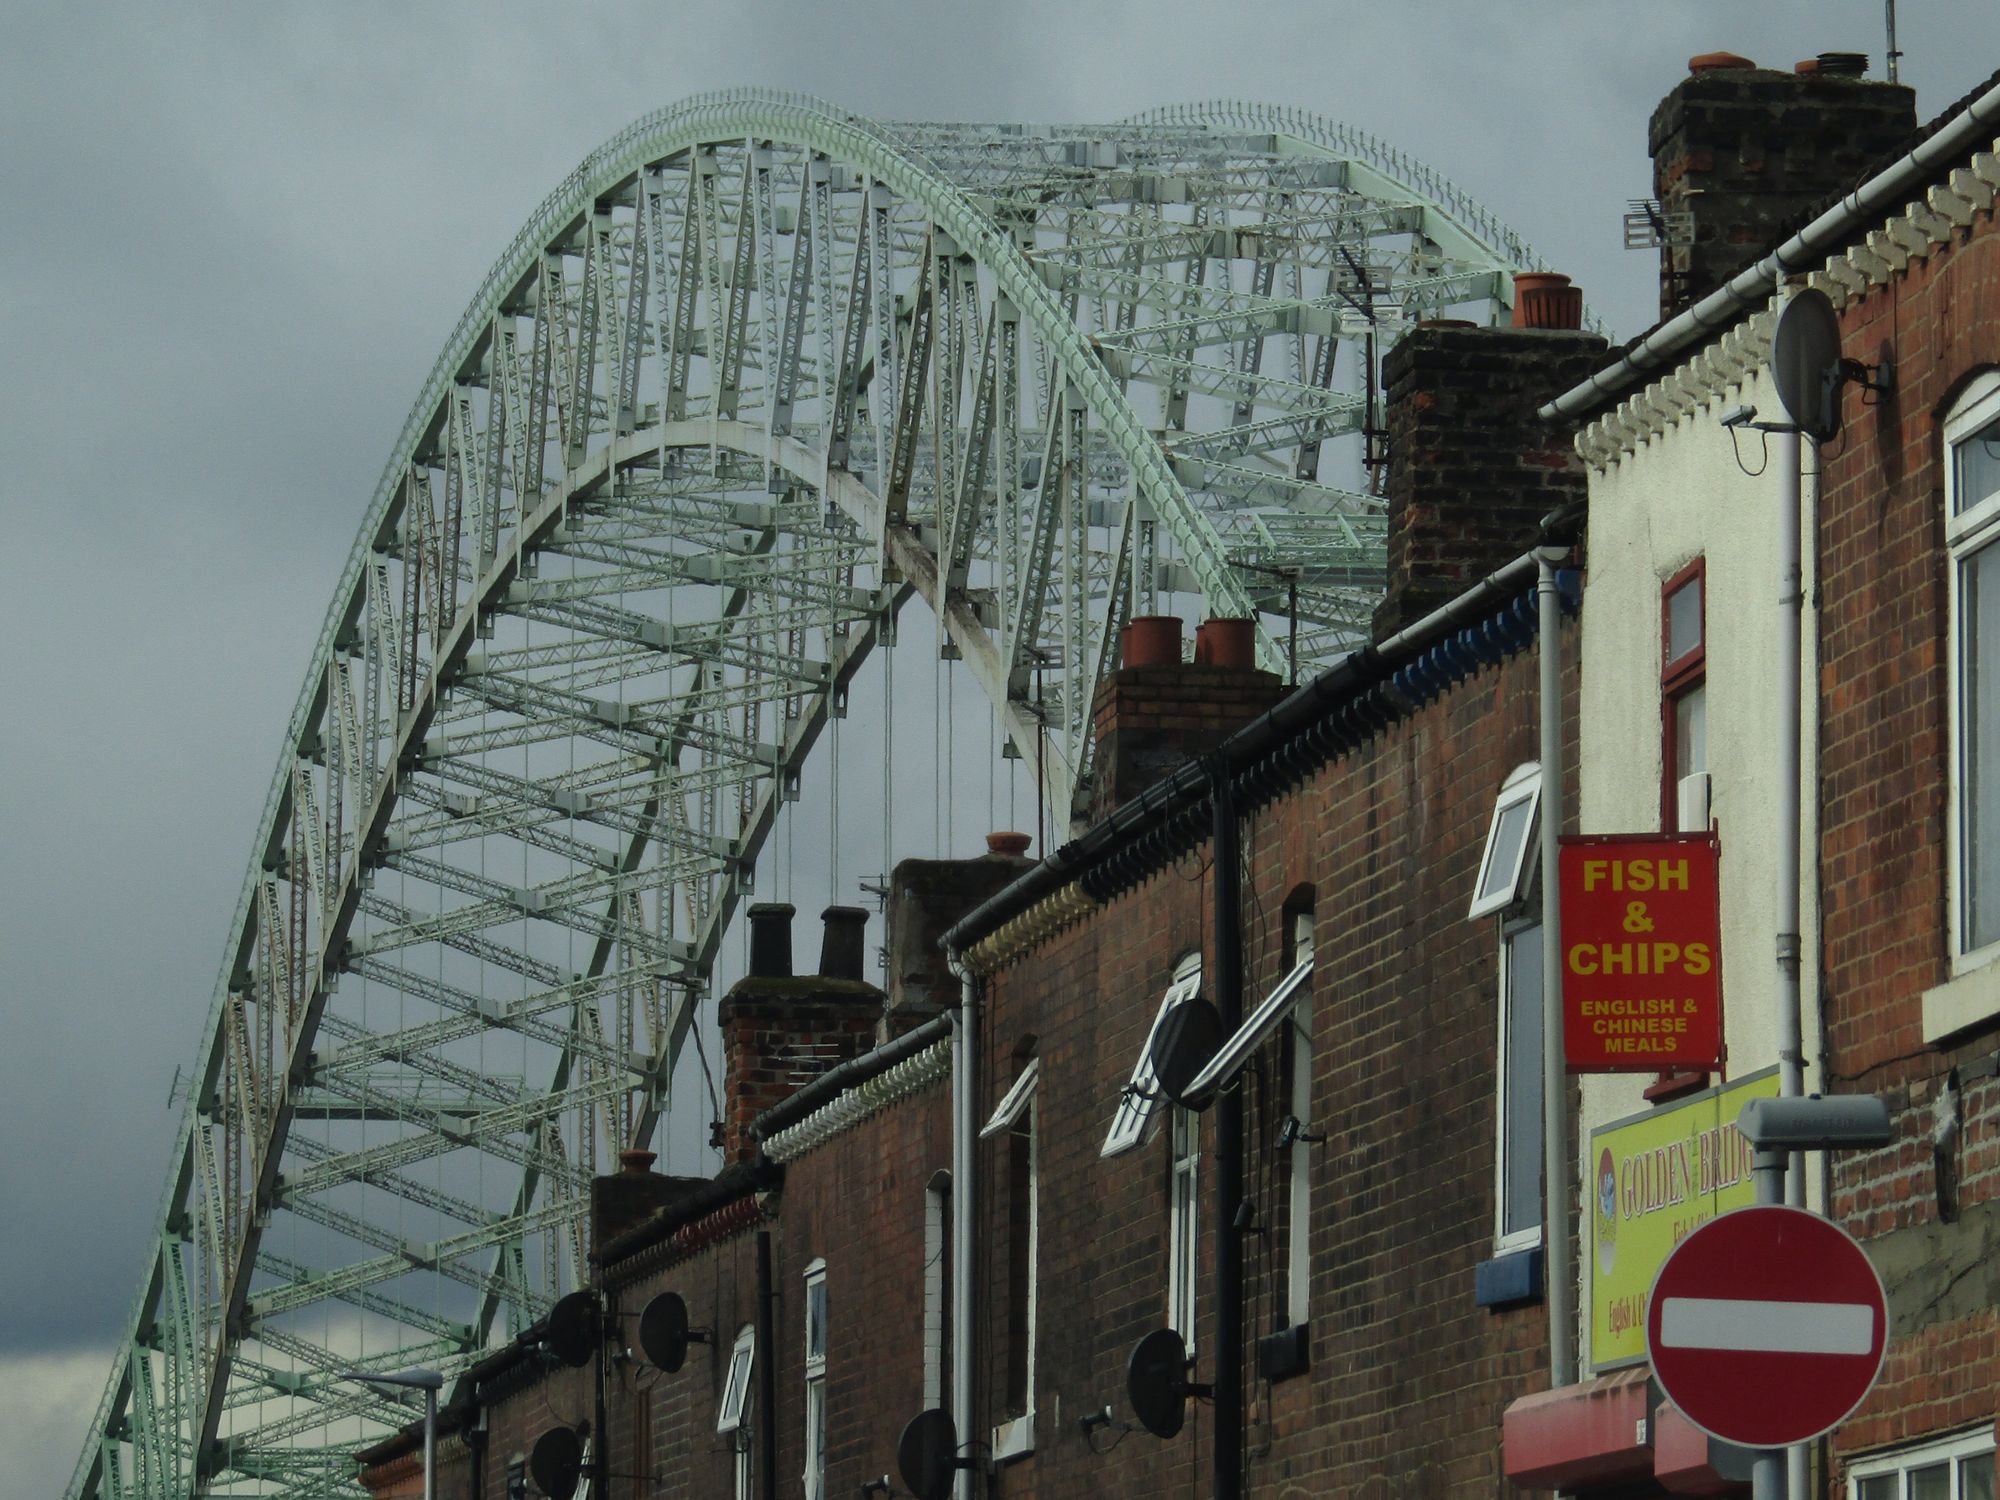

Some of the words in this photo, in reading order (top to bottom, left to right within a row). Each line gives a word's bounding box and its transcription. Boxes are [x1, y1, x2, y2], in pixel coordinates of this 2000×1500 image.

[1583, 859, 1689, 891] FISH
[1622, 900, 1655, 933] &
[1568, 942, 1711, 975] CHIPS
[1580, 999, 1675, 1016] ENGLISH
[1683, 998, 1698, 1013] &
[1593, 1017, 1687, 1034] CHINESE
[1605, 1037, 1677, 1053] MEALS
[1621, 1136, 1692, 1220] GOLDEN
[1699, 1120, 1753, 1197] BRIDG
